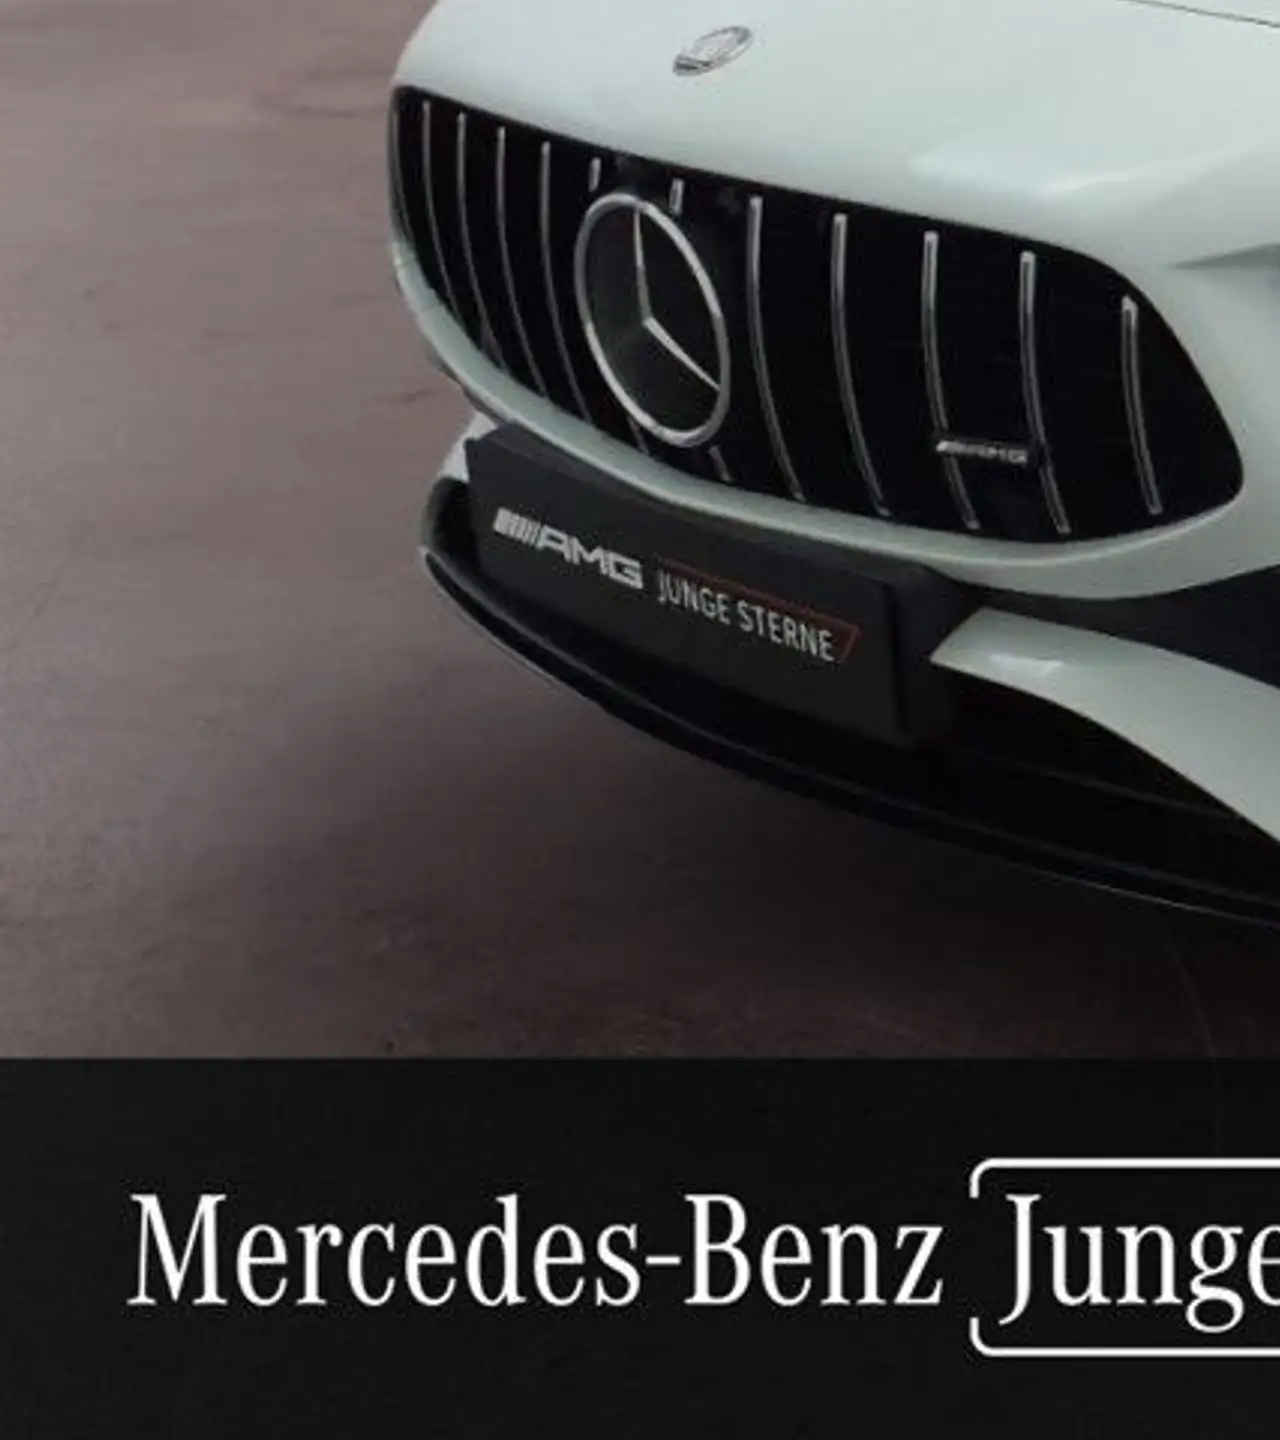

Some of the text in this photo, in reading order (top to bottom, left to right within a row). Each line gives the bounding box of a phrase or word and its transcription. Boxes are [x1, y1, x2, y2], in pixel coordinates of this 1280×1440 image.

[535, 523, 644, 590] AMG
[657, 567, 836, 661] JUNGE STERNE
